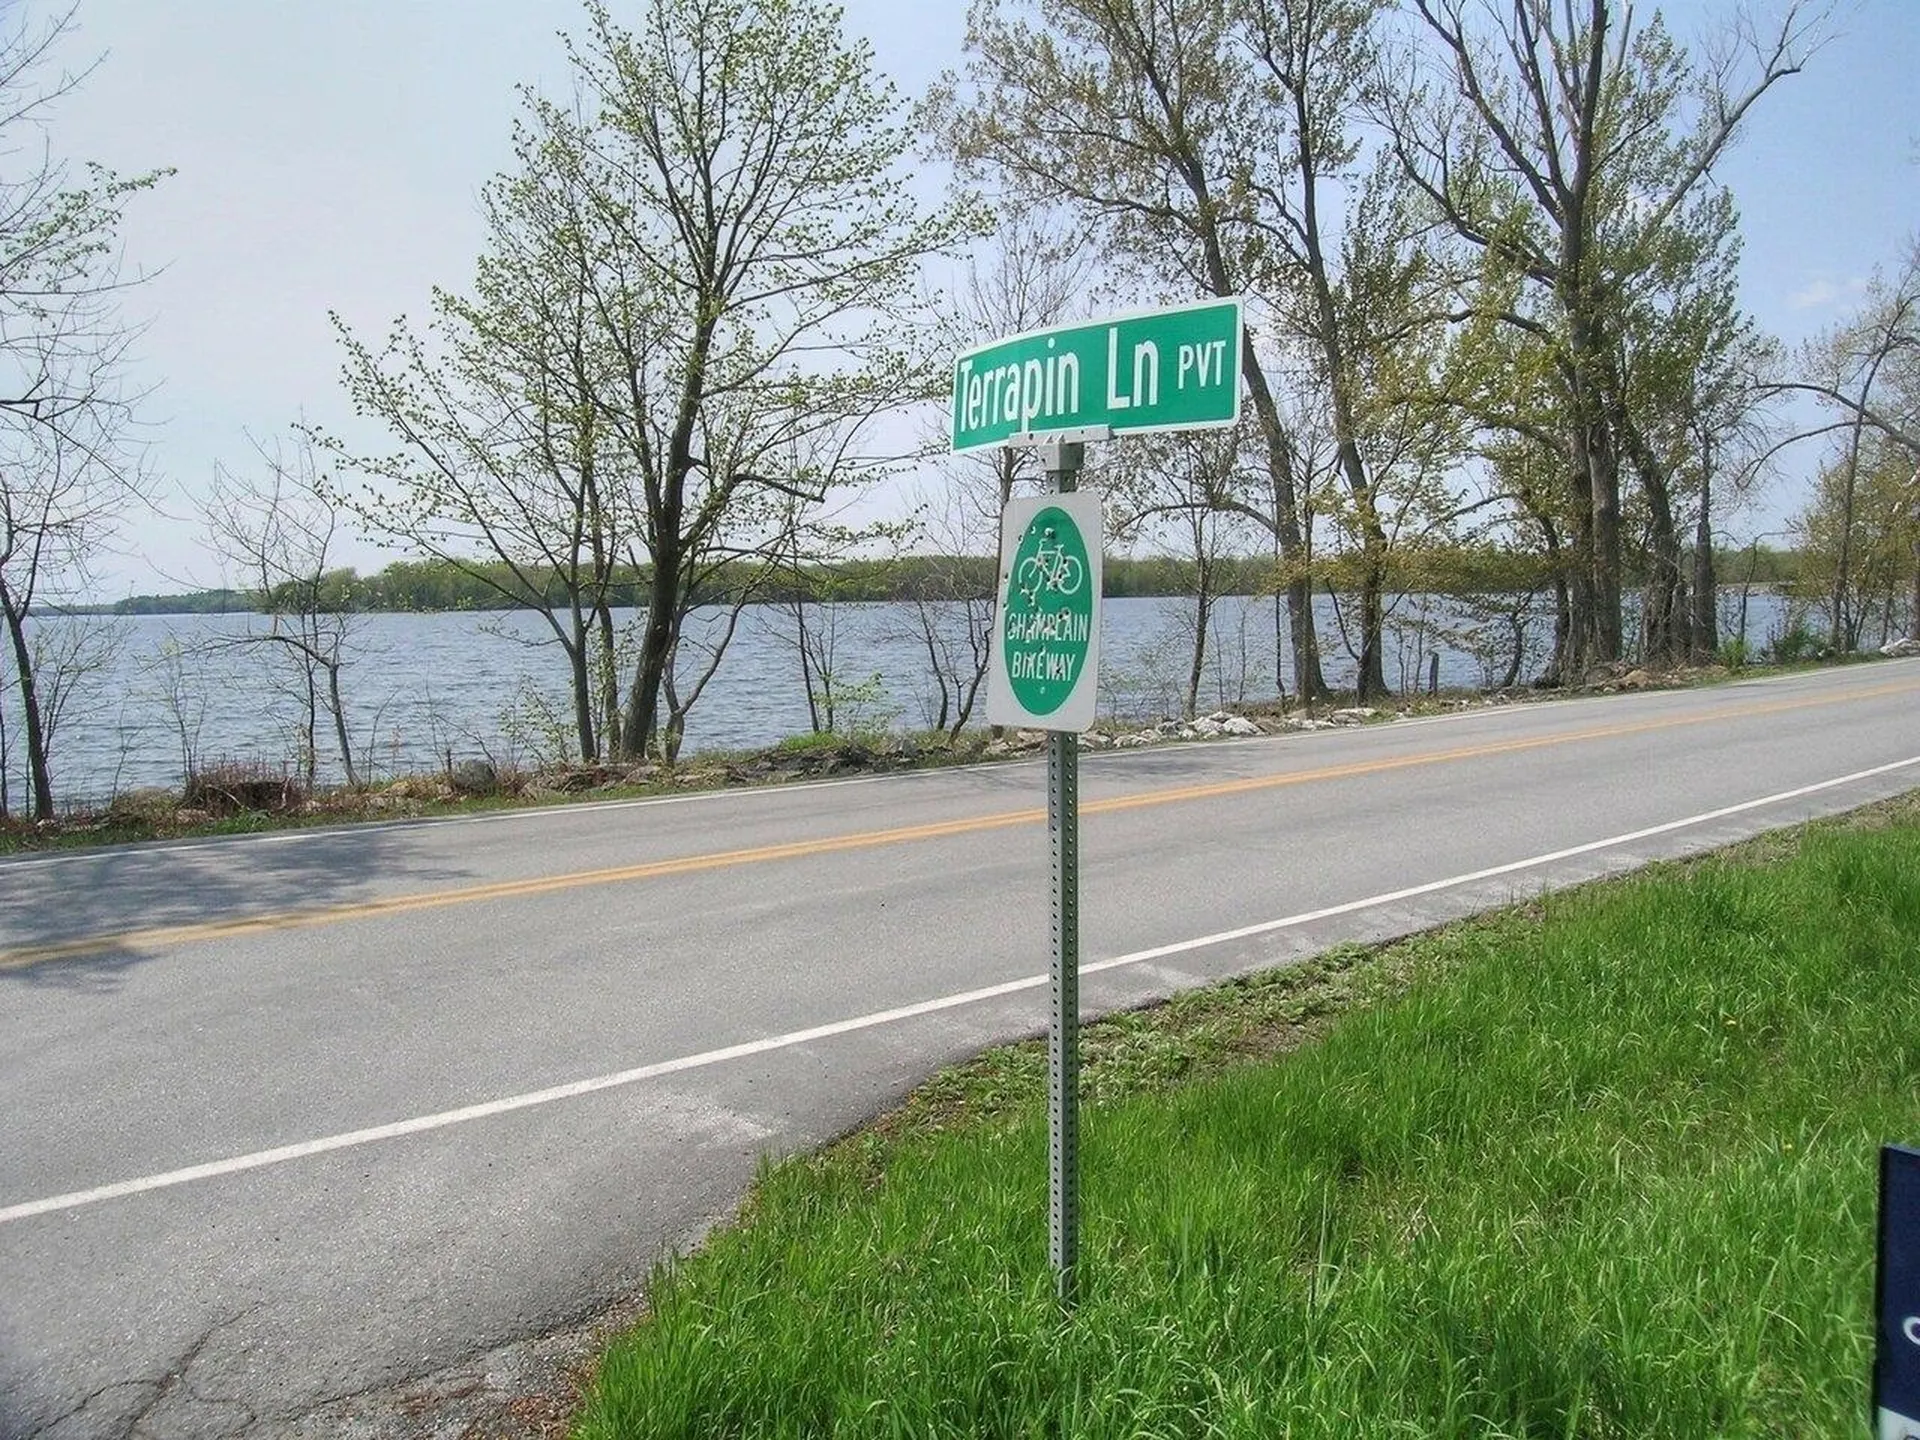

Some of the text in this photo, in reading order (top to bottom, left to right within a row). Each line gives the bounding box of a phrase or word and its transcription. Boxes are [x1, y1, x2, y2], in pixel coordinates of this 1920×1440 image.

[959, 327, 1226, 433] Terrapin Ln PVT
[1011, 651, 1076, 682] BIKEWAY
